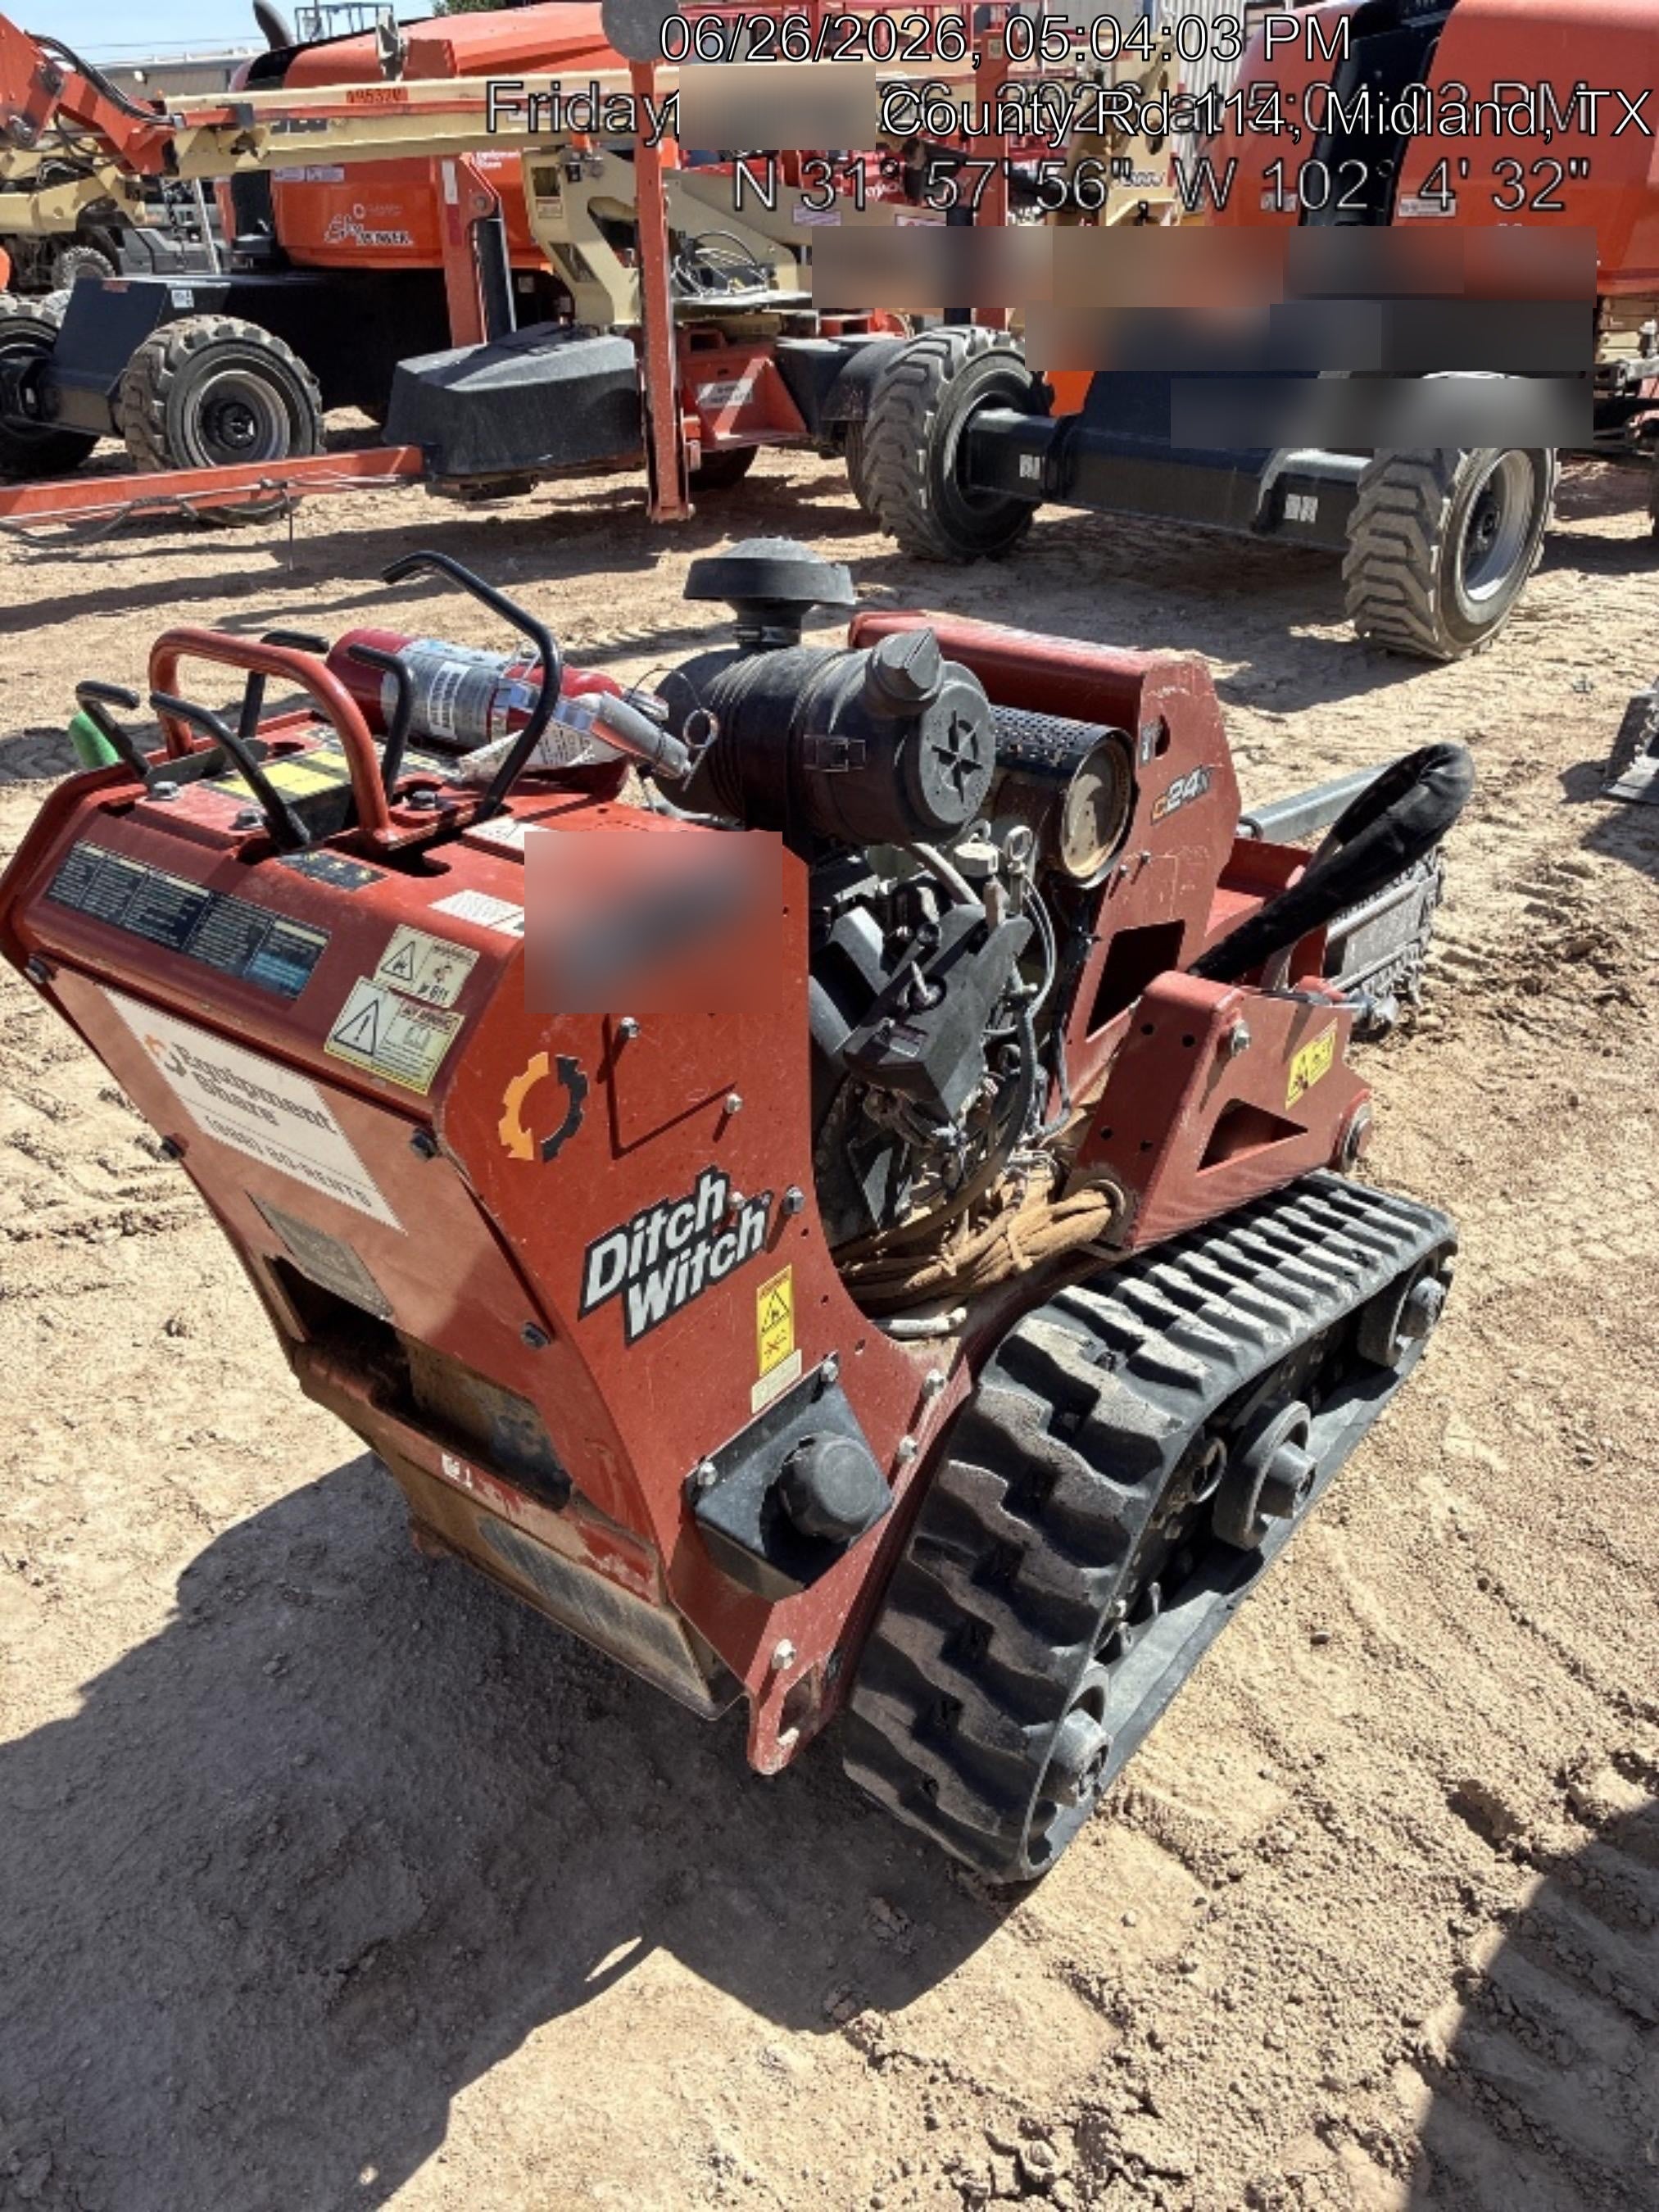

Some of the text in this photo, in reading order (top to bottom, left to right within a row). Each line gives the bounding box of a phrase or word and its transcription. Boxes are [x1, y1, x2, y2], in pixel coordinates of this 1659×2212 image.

[171, 1042, 338, 1135] Equipment
[191, 1071, 280, 1127] Share
[581, 1169, 728, 1312] Ditch
[625, 1203, 770, 1342] Witch
